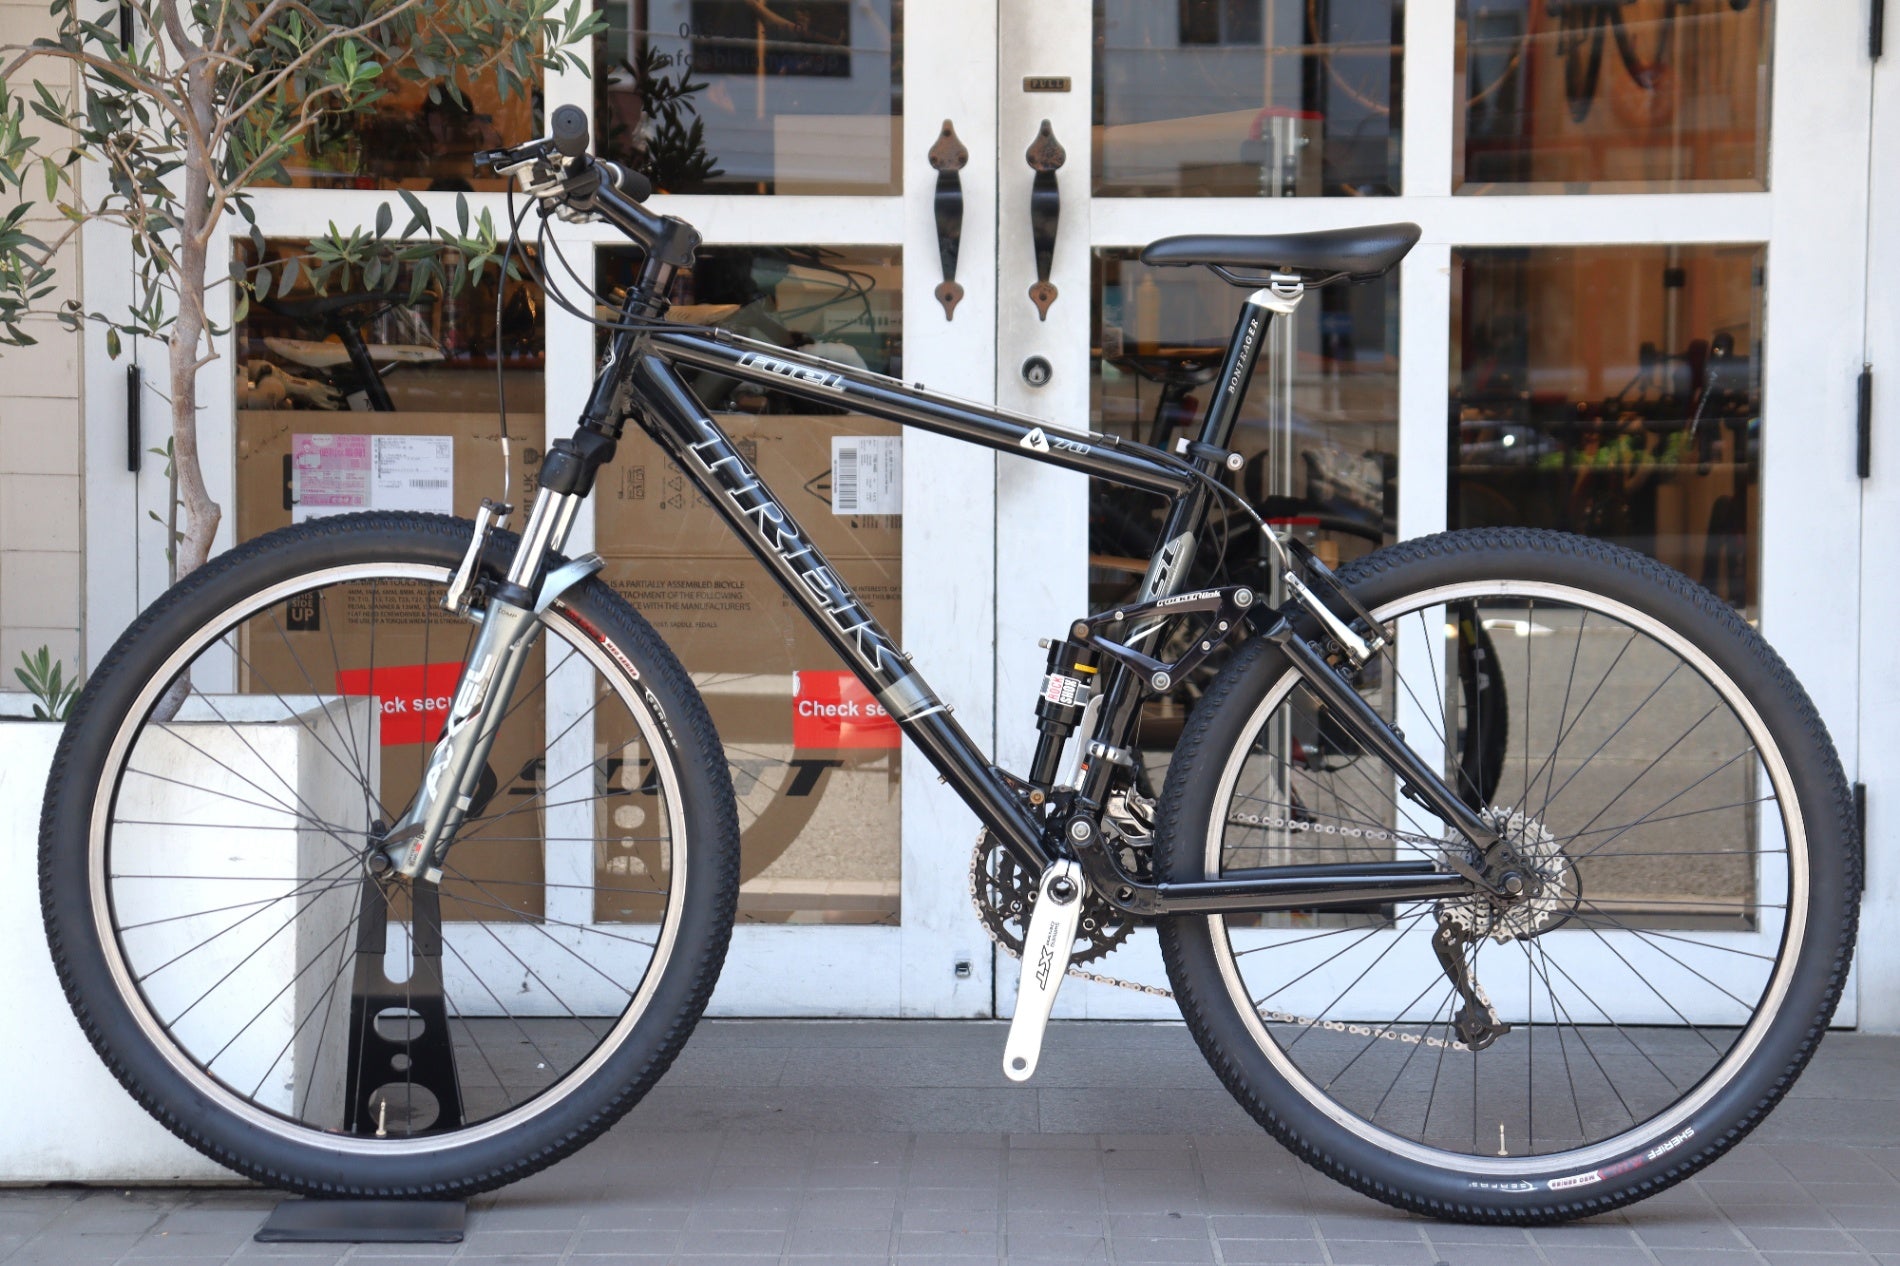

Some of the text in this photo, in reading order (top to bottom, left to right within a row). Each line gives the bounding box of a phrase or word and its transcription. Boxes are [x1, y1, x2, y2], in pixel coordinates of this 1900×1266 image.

[1032, 79, 1063, 89] PULL
[1228, 318, 1259, 395] BONTRAGER
[690, 420, 904, 671] TREK
[618, 580, 625, 588] A
[626, 580, 665, 588] PARTIALLY
[667, 580, 712, 589] ASSEMBLED
[714, 580, 745, 589] BICYCLE
[667, 591, 679, 600] OF
[680, 591, 694, 600] THE
[696, 591, 743, 600] FOLLOWING
[292, 600, 313, 608] SIDE
[643, 601, 663, 610] WITH
[664, 601, 679, 610] THE
[292, 607, 314, 621] UP
[1047, 676, 1063, 700] ROCK
[799, 700, 860, 717] Check
[426, 654, 492, 803] AXEL
[1036, 944, 1054, 991] XT
[1647, 1126, 1695, 1160] SHERIFF
[1469, 1181, 1530, 1190] SERFAS
